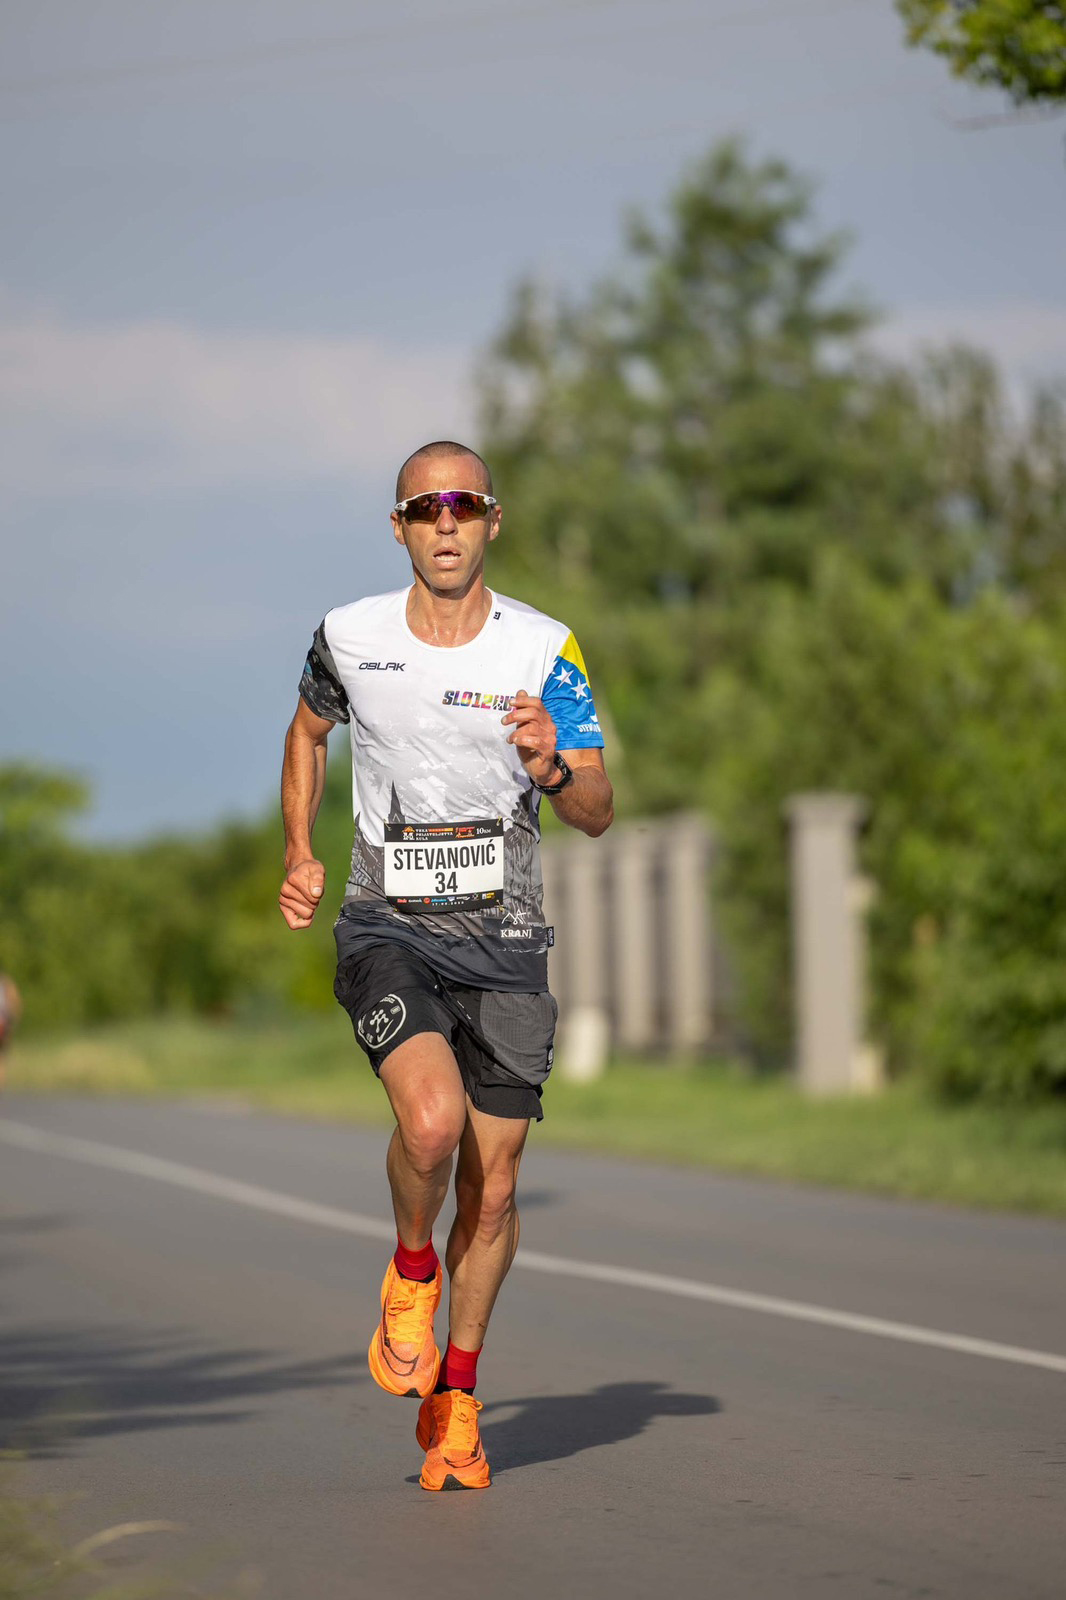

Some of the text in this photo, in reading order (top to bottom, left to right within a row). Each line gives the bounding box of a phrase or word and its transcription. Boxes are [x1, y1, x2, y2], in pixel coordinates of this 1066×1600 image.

[393, 839, 496, 871] STEVANOVIĆ
[434, 871, 458, 894] 34
[500, 929, 532, 939] KRANJ
